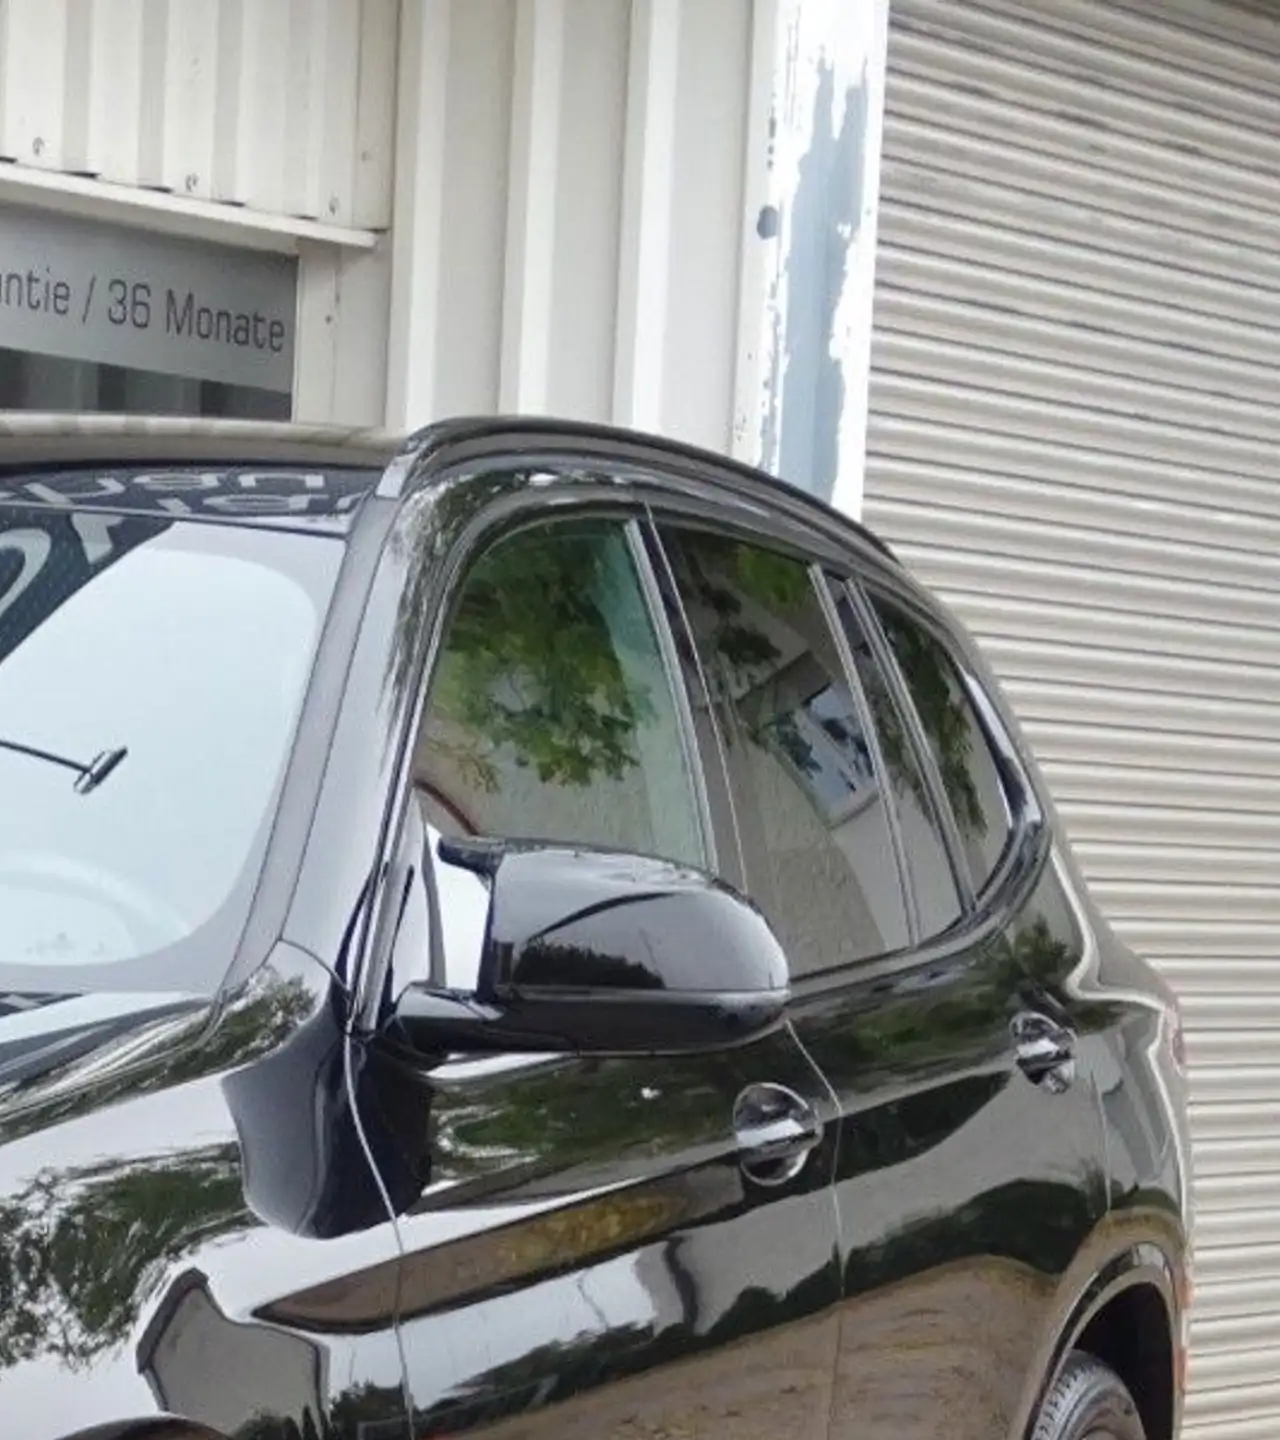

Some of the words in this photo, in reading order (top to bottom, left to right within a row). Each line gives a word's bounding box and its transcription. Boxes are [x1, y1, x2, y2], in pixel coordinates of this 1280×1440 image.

[82, 275, 96, 325] /
[107, 278, 152, 330] 36
[165, 288, 285, 352] Monate
